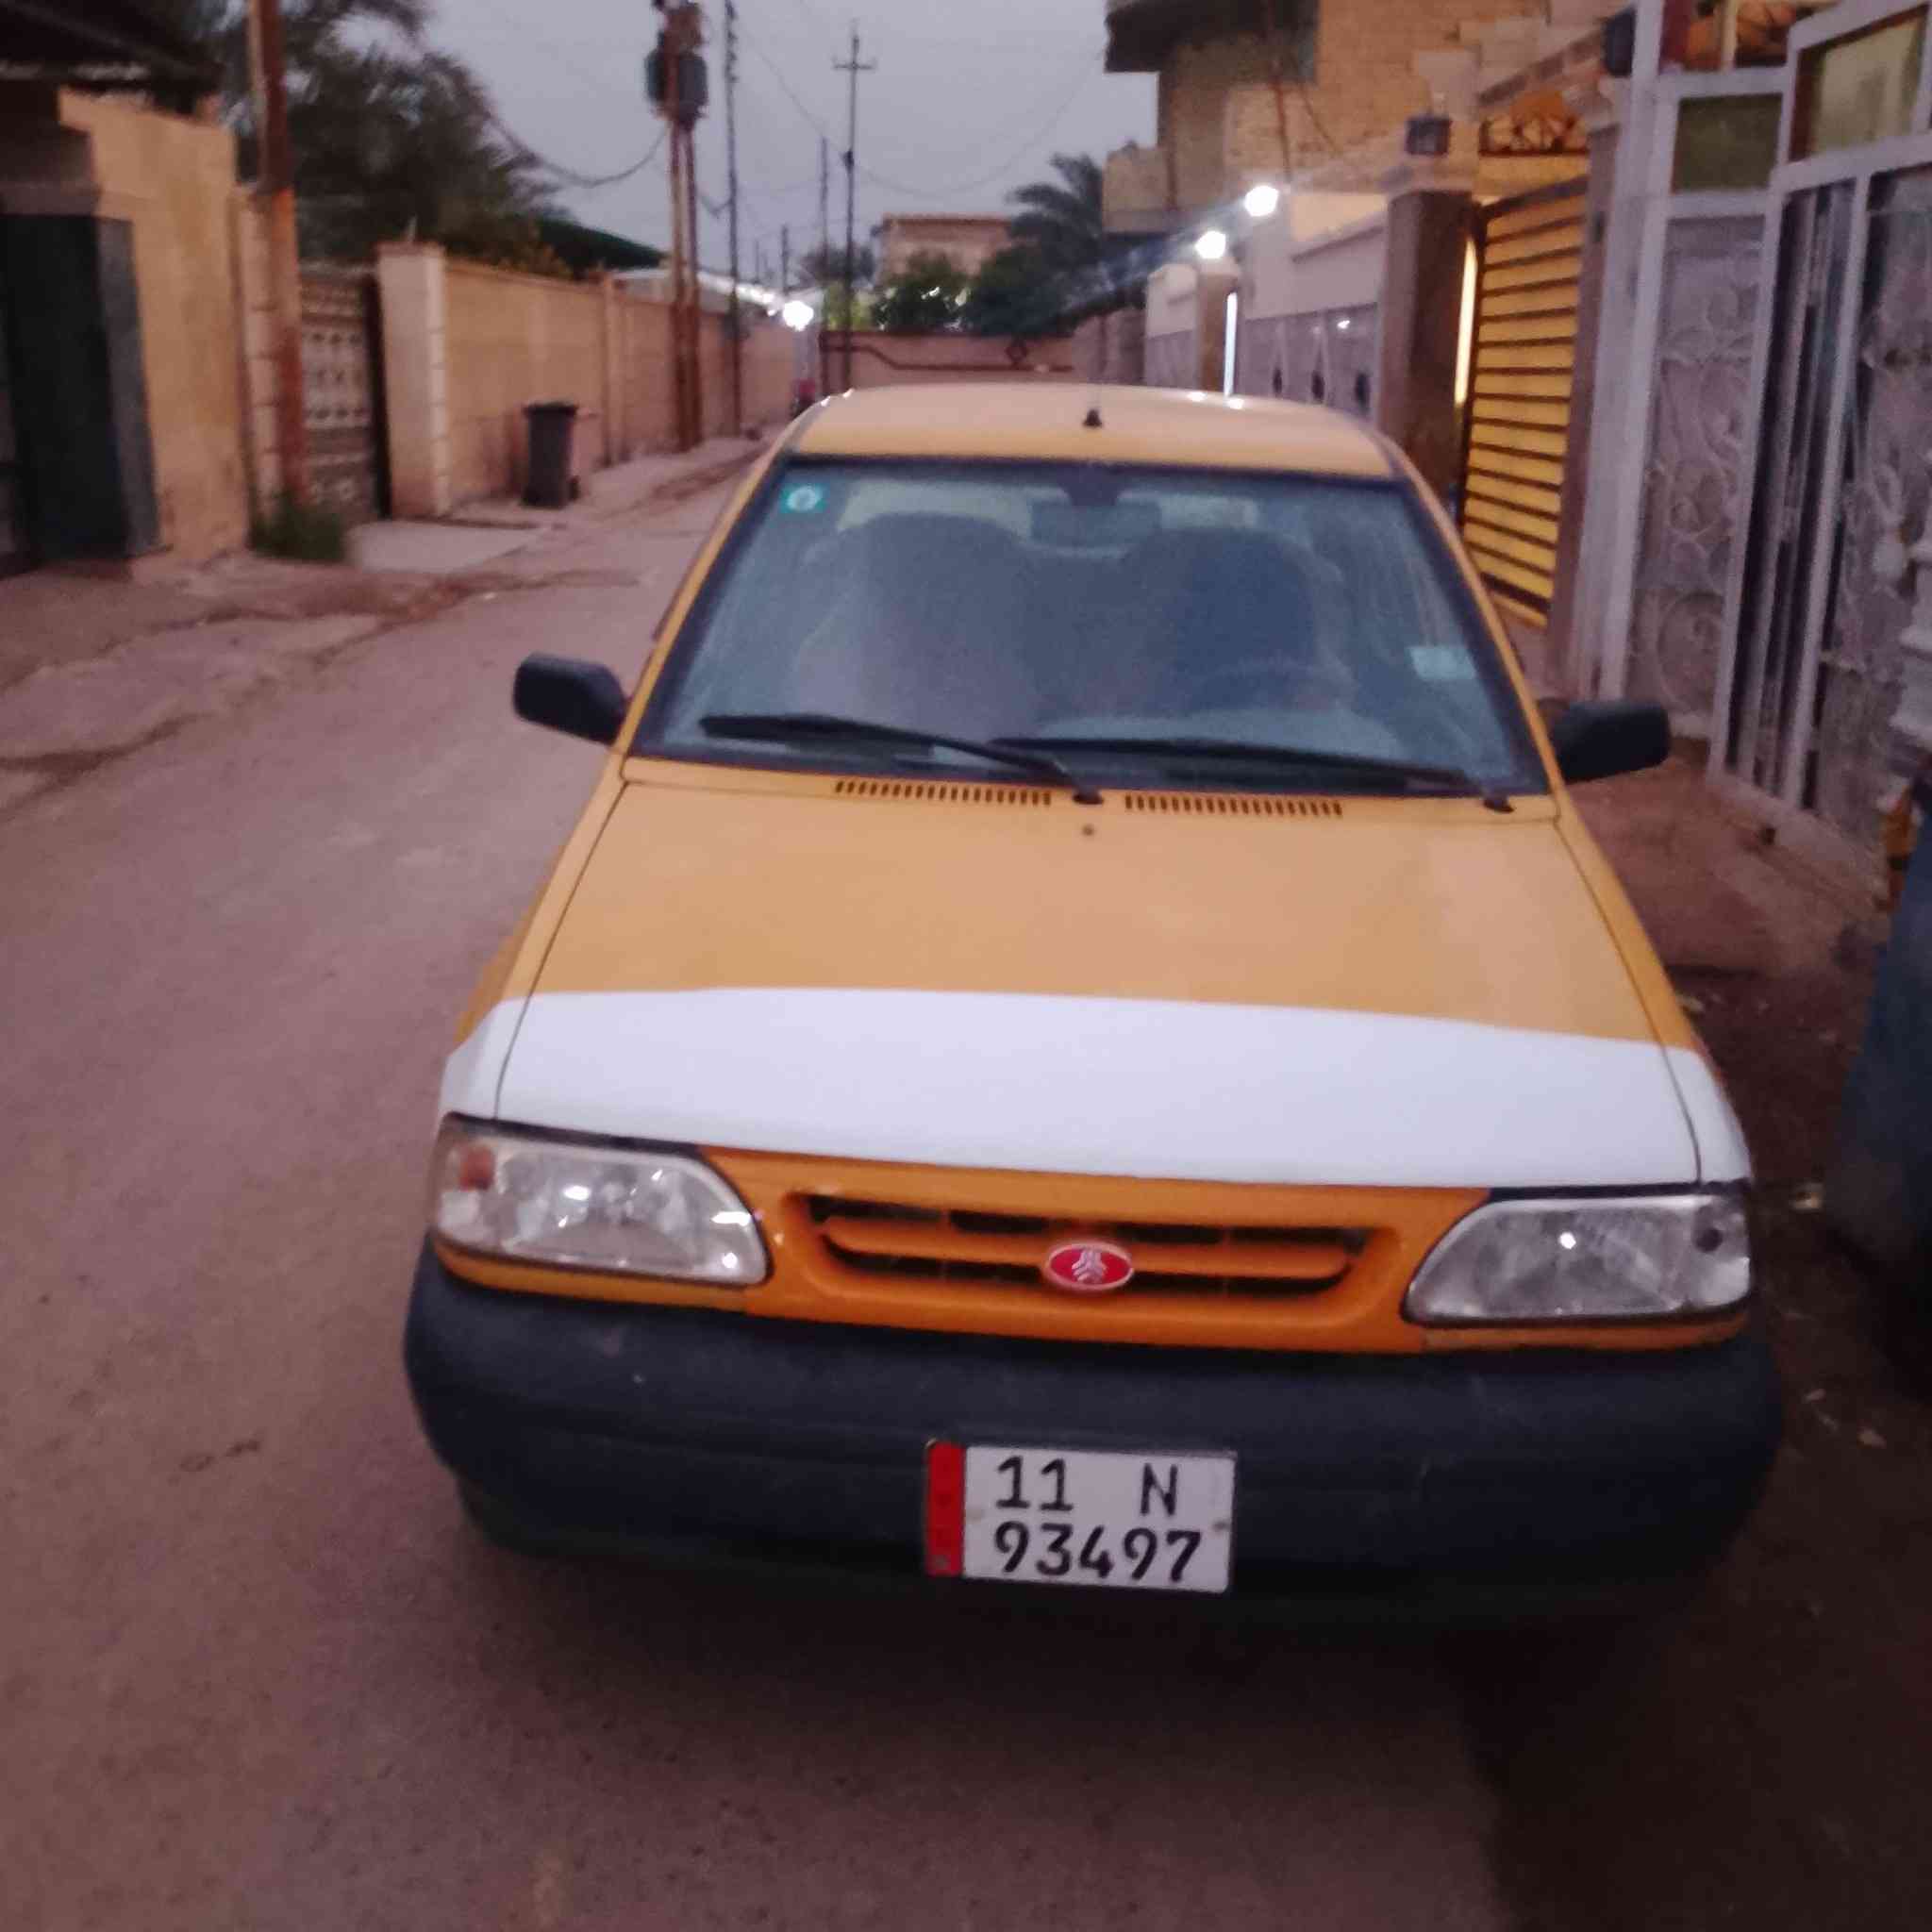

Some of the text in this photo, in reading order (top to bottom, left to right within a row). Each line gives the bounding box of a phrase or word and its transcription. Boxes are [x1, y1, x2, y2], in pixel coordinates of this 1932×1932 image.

[995, 1456, 1179, 1516] 11 N
[994, 1521, 1201, 1582] 93497
